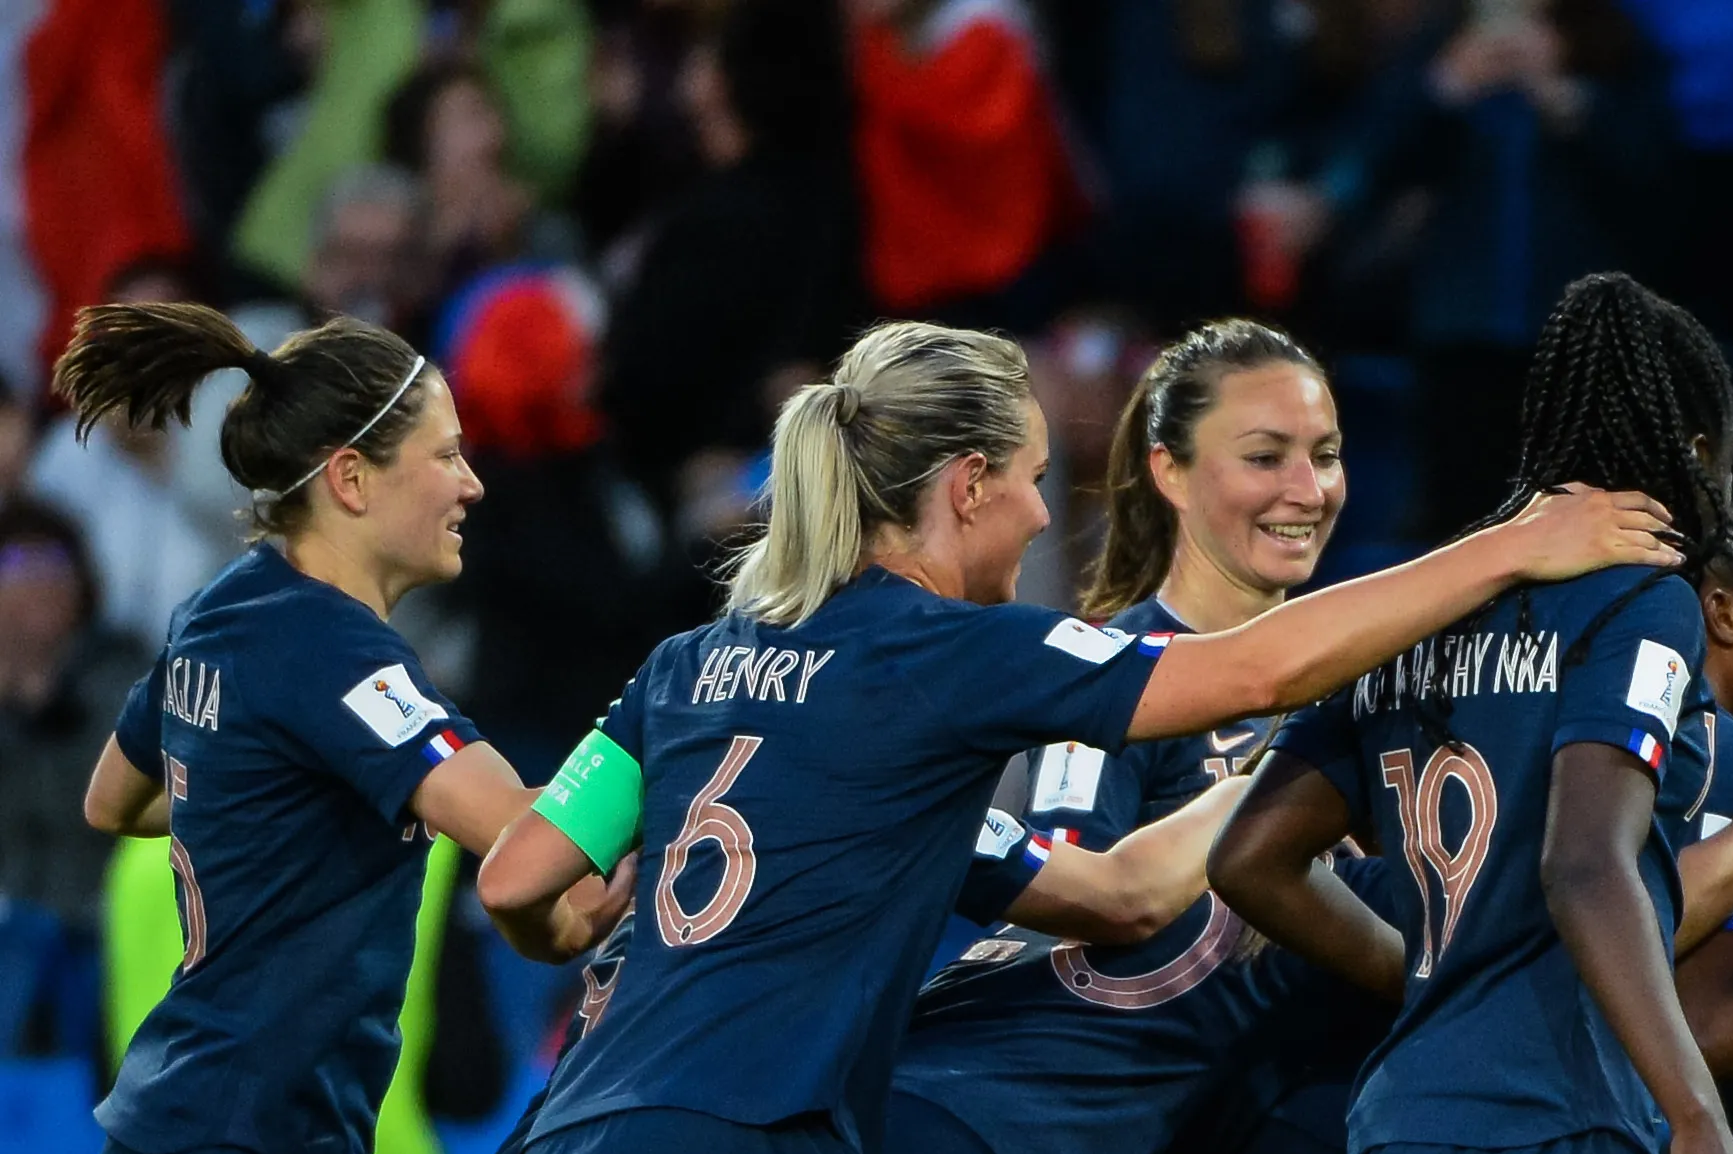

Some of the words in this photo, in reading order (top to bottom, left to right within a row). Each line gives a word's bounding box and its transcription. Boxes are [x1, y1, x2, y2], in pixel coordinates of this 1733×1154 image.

[691, 645, 835, 705] HENRY
[1493, 630, 1558, 694] NKA
[655, 735, 764, 948] 6
[1379, 741, 1498, 979] 19
